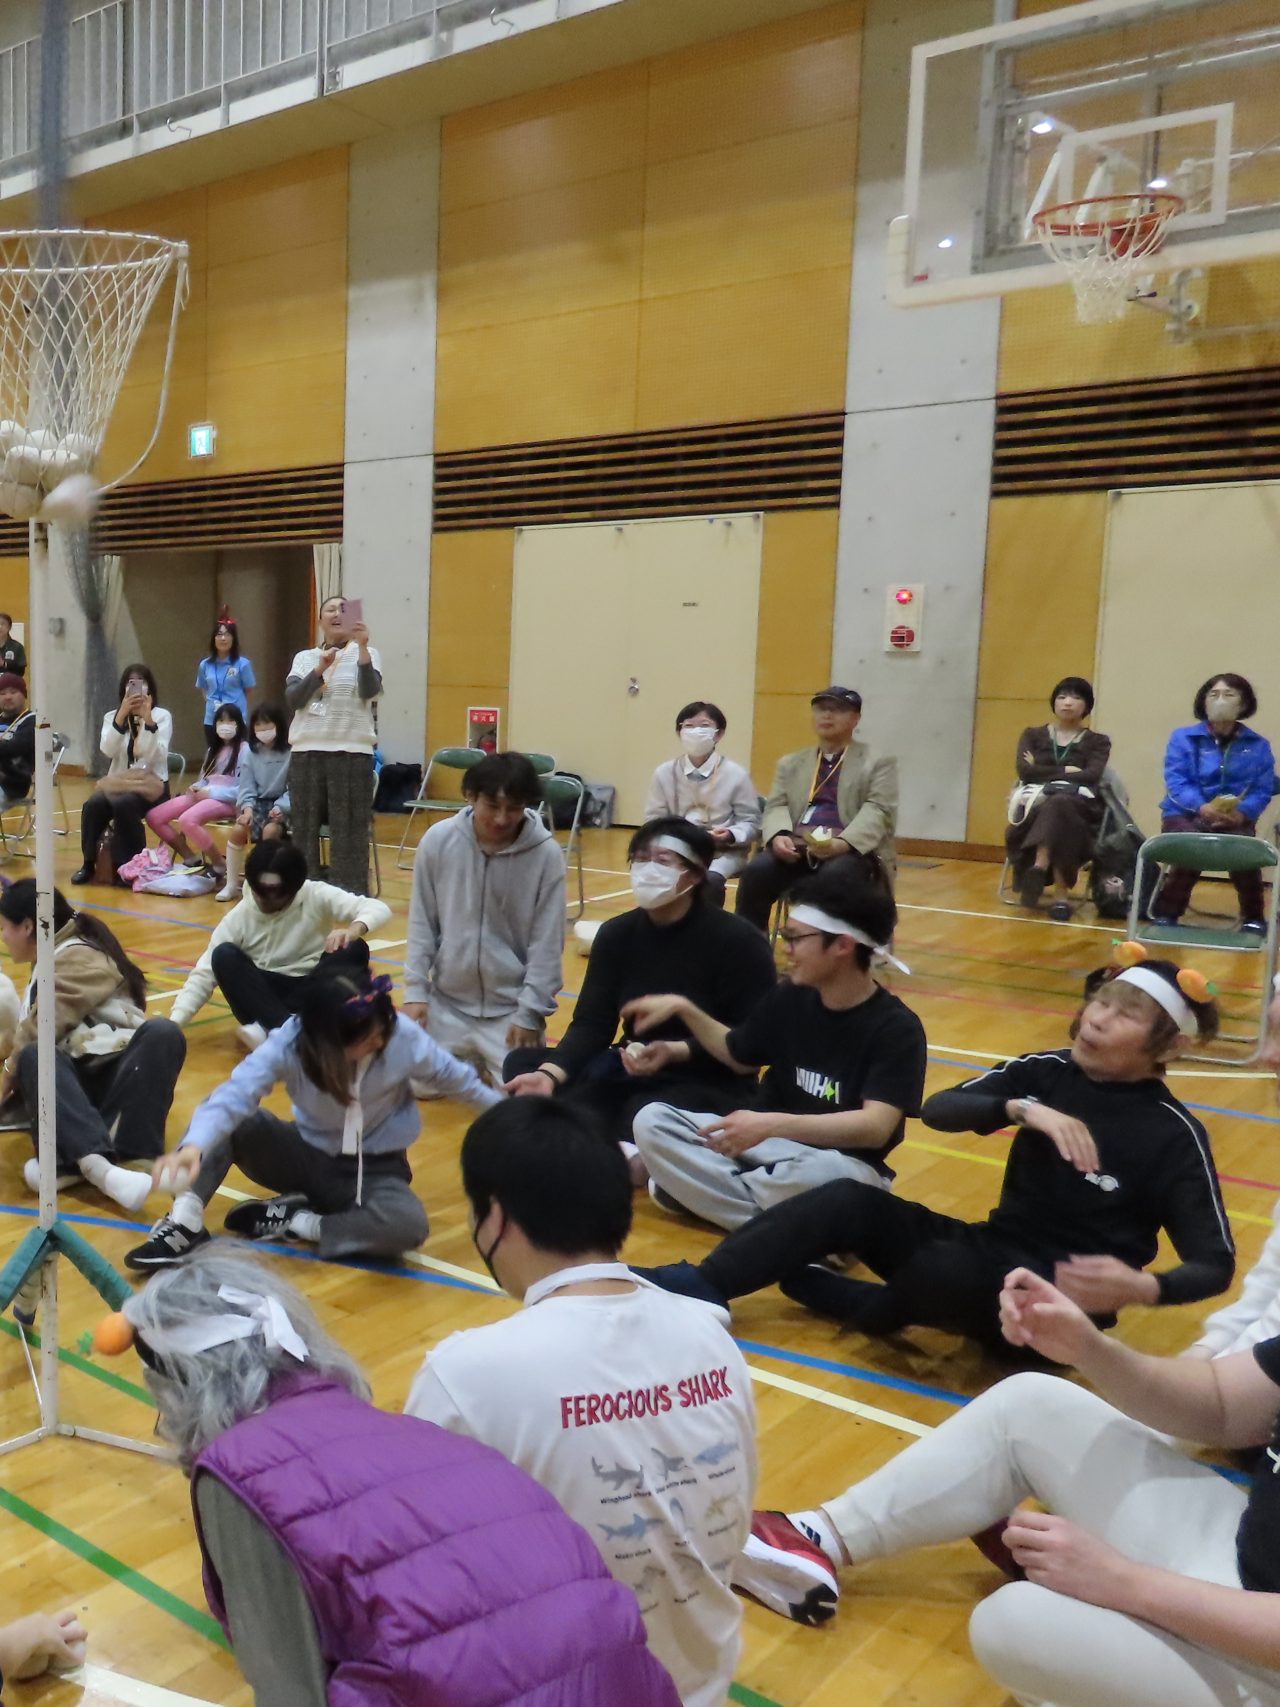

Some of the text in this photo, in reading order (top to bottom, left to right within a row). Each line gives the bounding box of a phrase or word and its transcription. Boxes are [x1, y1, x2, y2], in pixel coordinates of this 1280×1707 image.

[266, 1203, 287, 1219] N
[164, 1229, 191, 1253] N
[560, 1366, 733, 1429] FEROCIOUS SHARK
